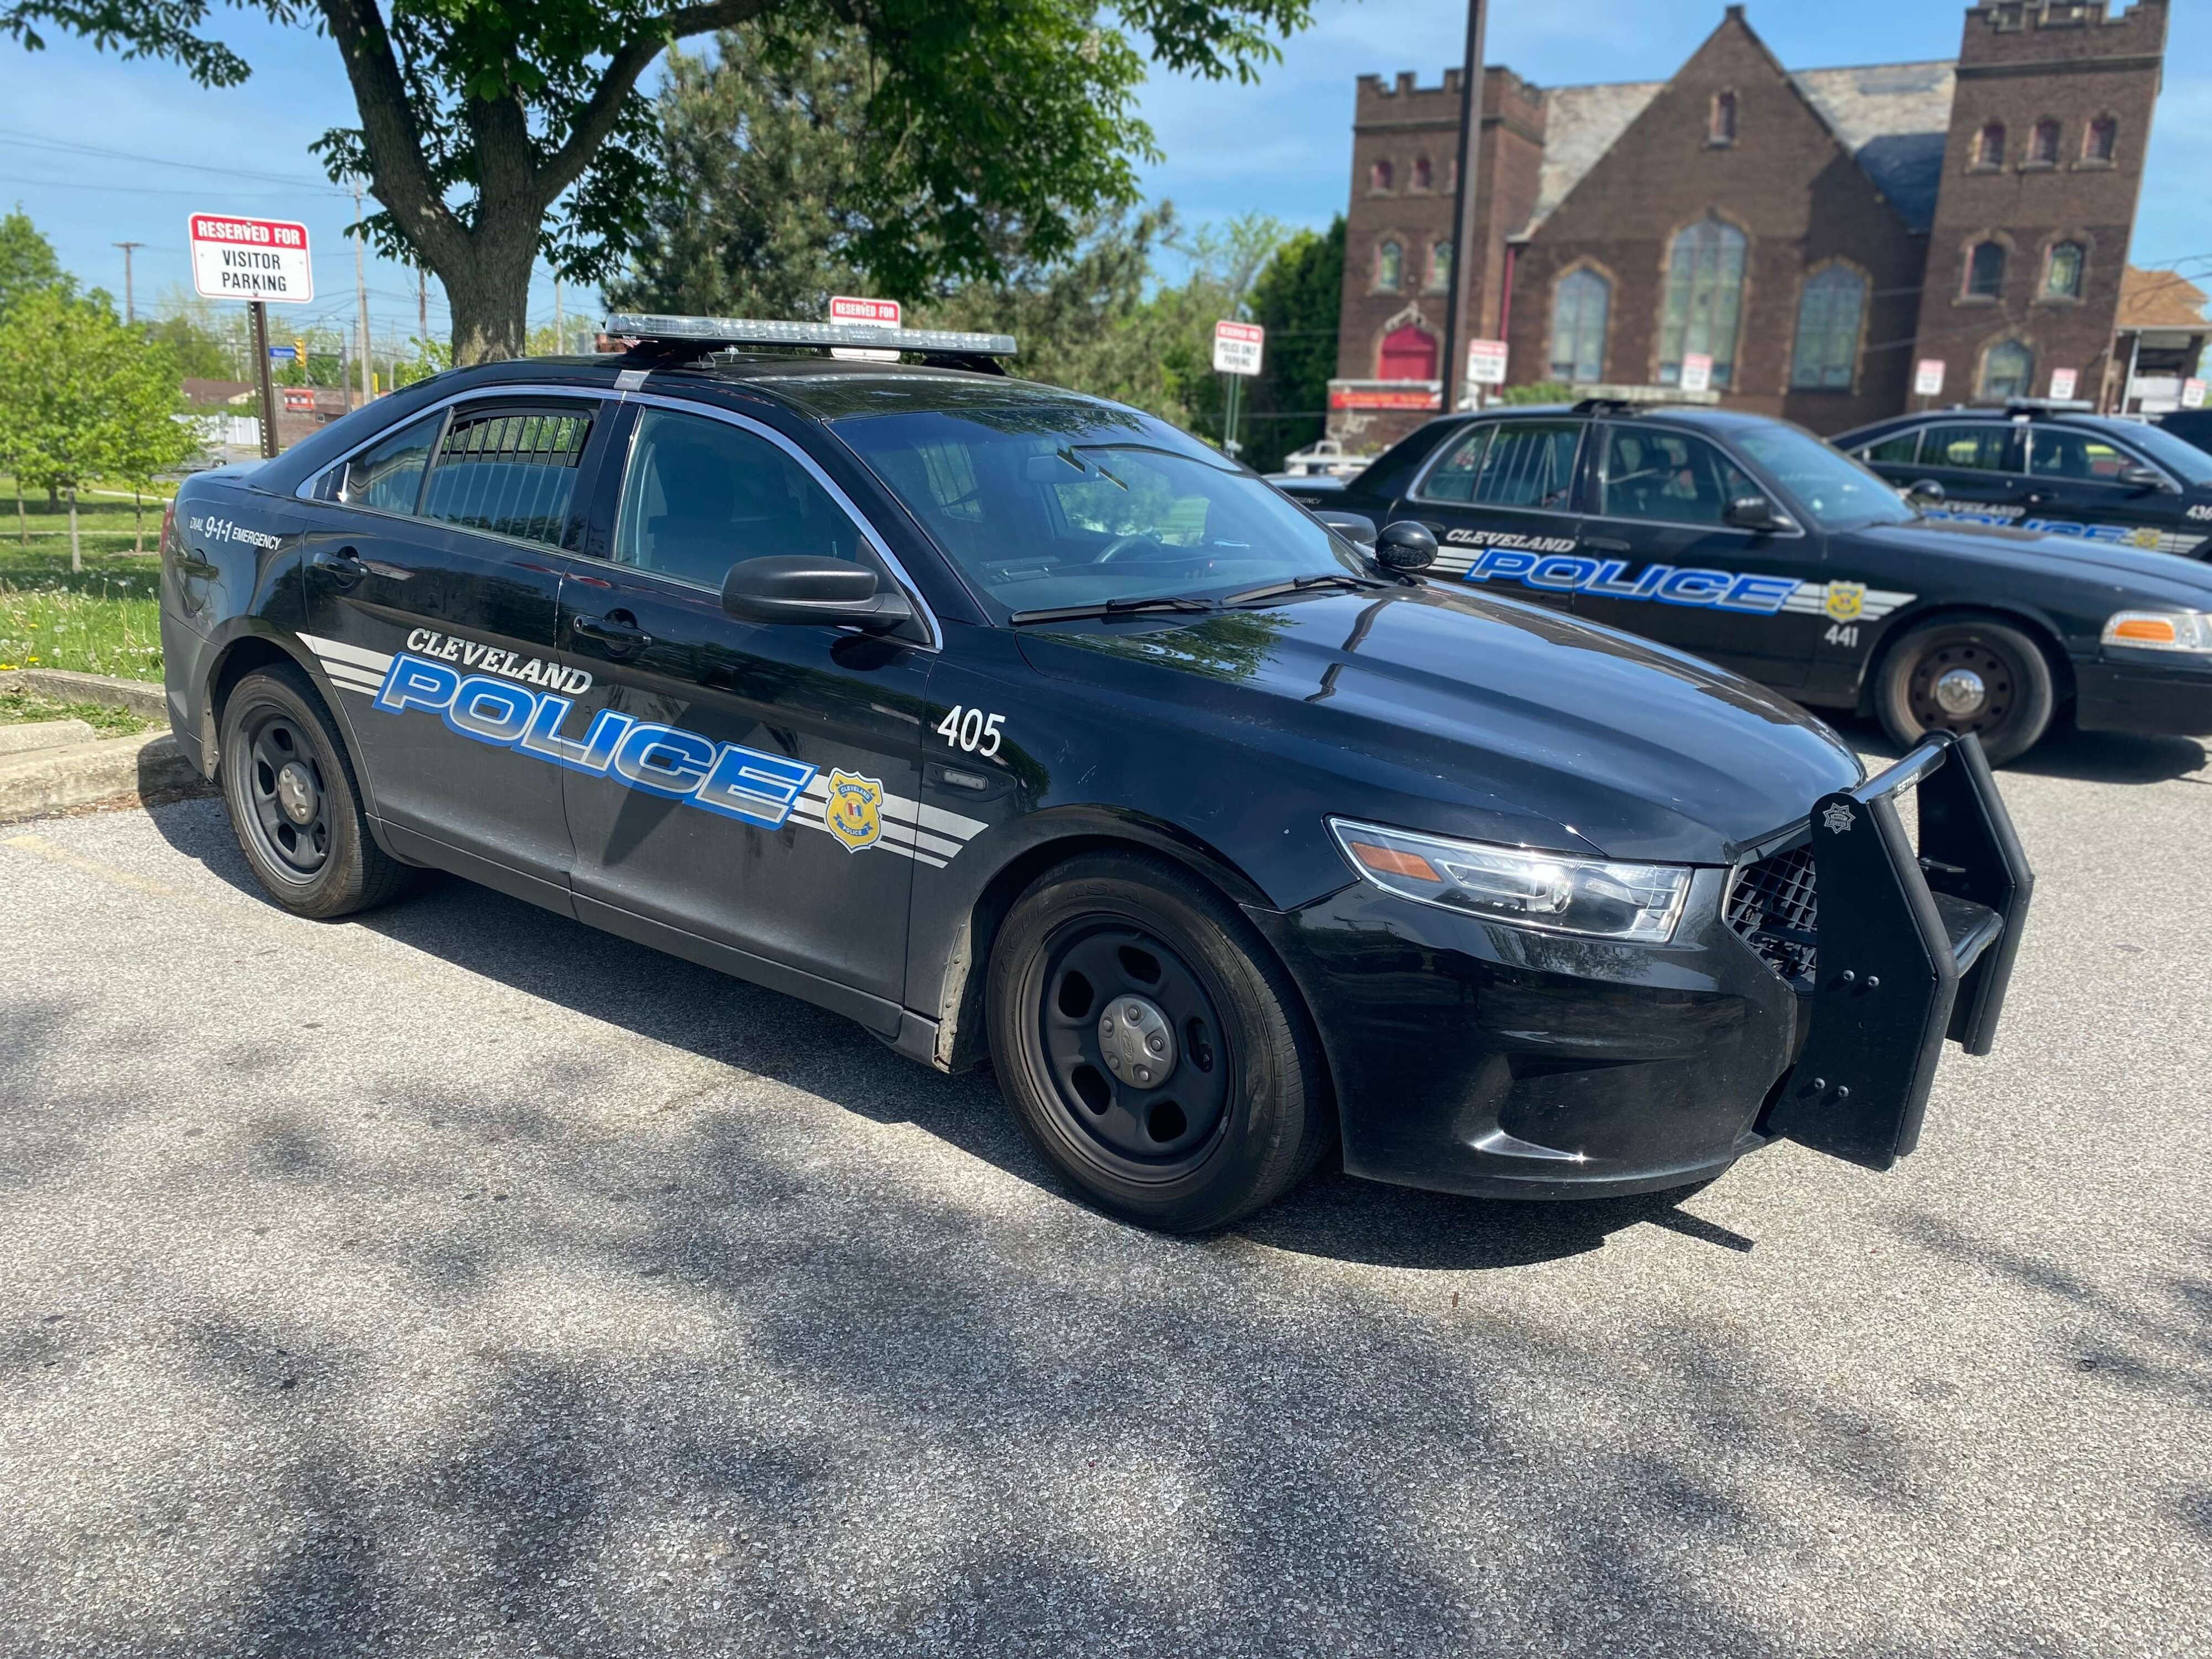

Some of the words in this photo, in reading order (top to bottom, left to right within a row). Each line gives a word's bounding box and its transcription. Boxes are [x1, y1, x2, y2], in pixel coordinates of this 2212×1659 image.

[197, 220, 269, 243] RESERVED
[274, 228, 301, 245] FOR
[222, 249, 281, 270] VISITOR
[221, 272, 287, 292] PARKING
[835, 302, 876, 317] RESERVED
[879, 306, 895, 319] FOR
[190, 517, 204, 532] DIAL
[205, 516, 233, 542] 9-1-1
[232, 527, 282, 551] EMERGENCY
[1445, 529, 1576, 552] CLEVELAND
[1463, 547, 1805, 616] POLICE
[1824, 624, 1859, 648] 441
[407, 628, 593, 695] CLEVELAND
[372, 652, 820, 830] POLICE
[937, 705, 1006, 757] 405
[840, 785, 870, 799] CLEVELAND
[842, 826, 862, 836] POLICE
